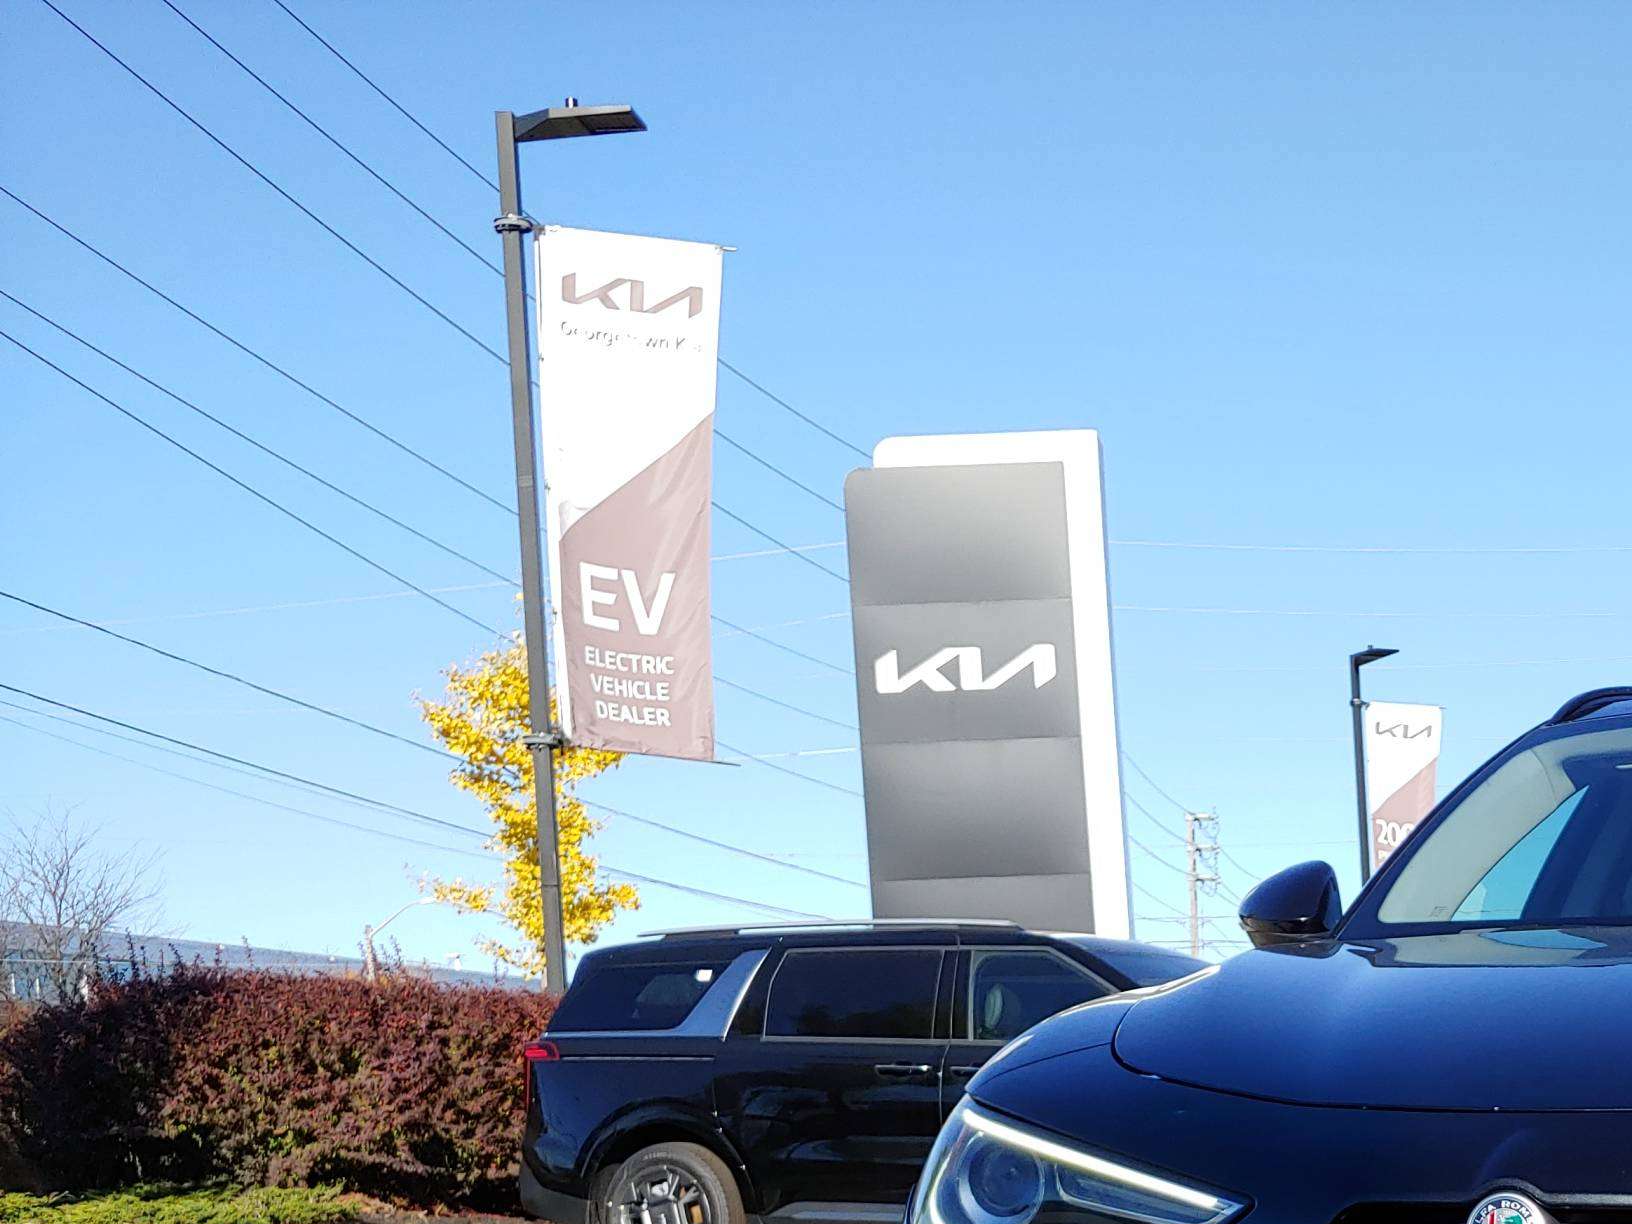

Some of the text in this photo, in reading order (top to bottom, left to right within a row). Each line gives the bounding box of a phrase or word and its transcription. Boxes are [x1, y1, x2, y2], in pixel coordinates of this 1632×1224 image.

[561, 272, 703, 319] KIA
[579, 561, 676, 635] EV
[584, 645, 675, 675] ELECTRIC
[874, 643, 1057, 694] KIA
[590, 672, 670, 701] VEHICLE
[595, 700, 671, 726] DEALER
[1375, 721, 1432, 739] KIA
